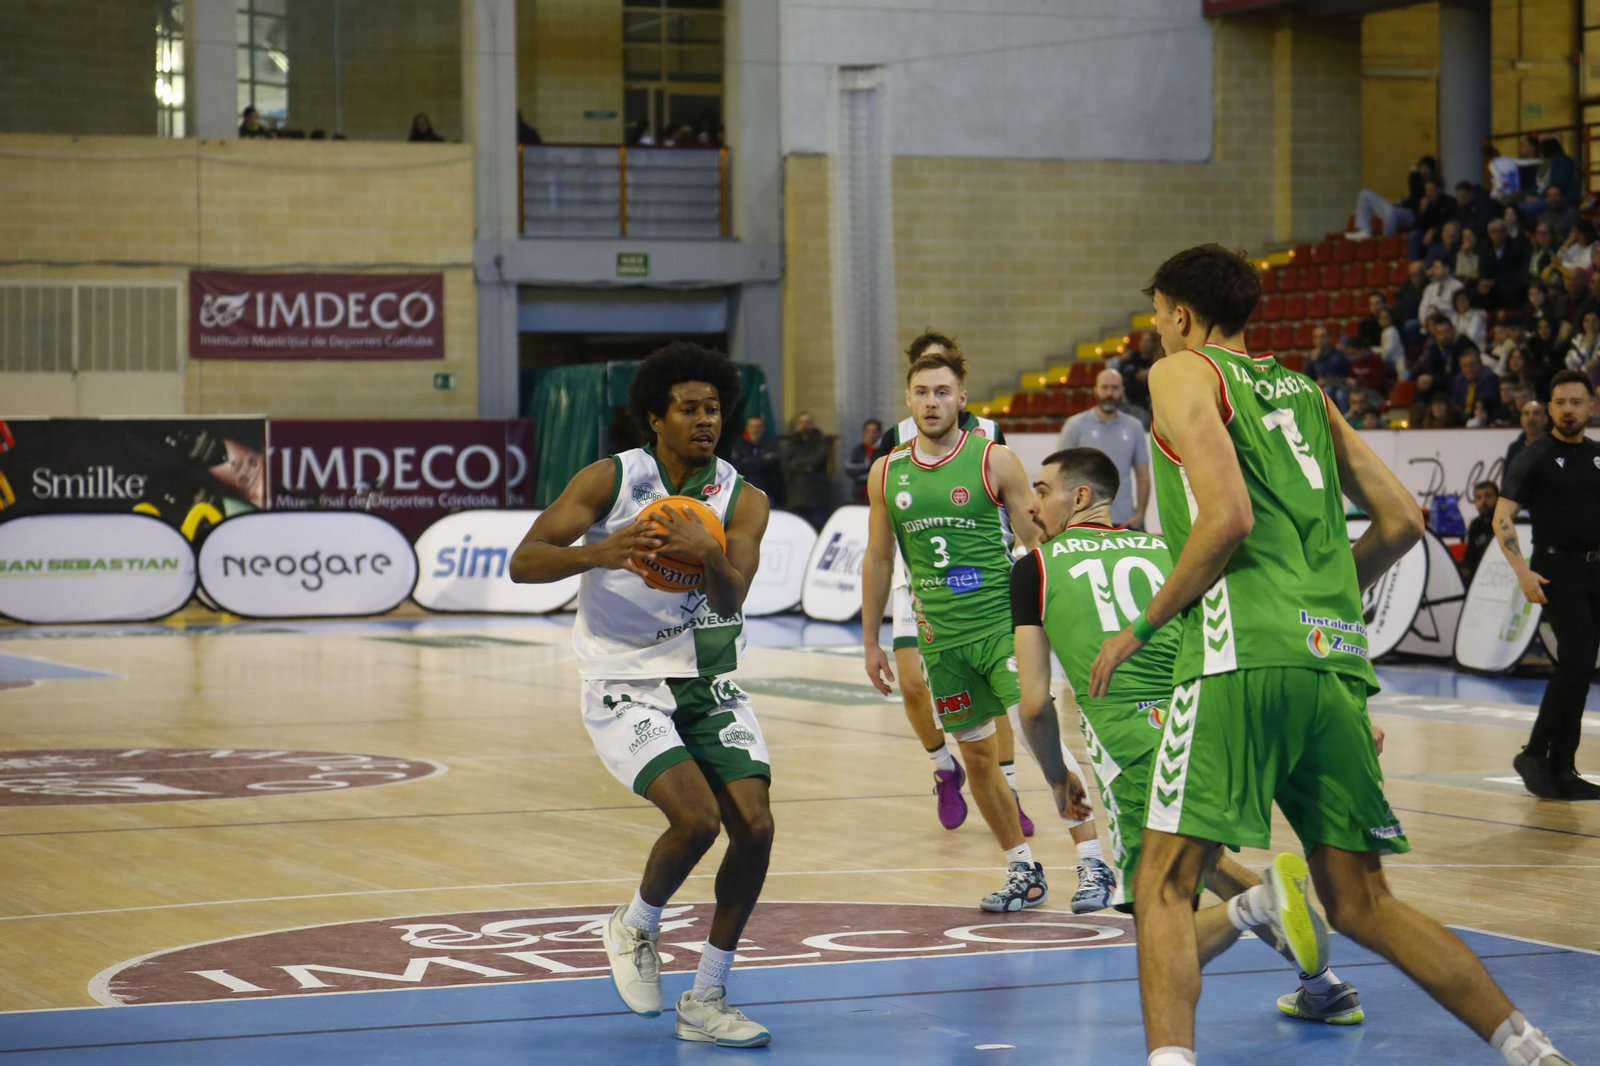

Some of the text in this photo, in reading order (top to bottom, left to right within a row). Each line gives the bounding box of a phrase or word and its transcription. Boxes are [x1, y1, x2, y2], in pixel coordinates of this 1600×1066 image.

[255, 292, 436, 328] IMDECO
[31, 465, 146, 500] Smilke
[280, 444, 500, 491] IMDECO
[929, 535, 950, 569] 3
[1051, 535, 1169, 558] ARDANZA
[47, 557, 179, 571] SEBASTIAN
[1067, 555, 1166, 633] 10
[628, 725, 668, 754] IMDECO
